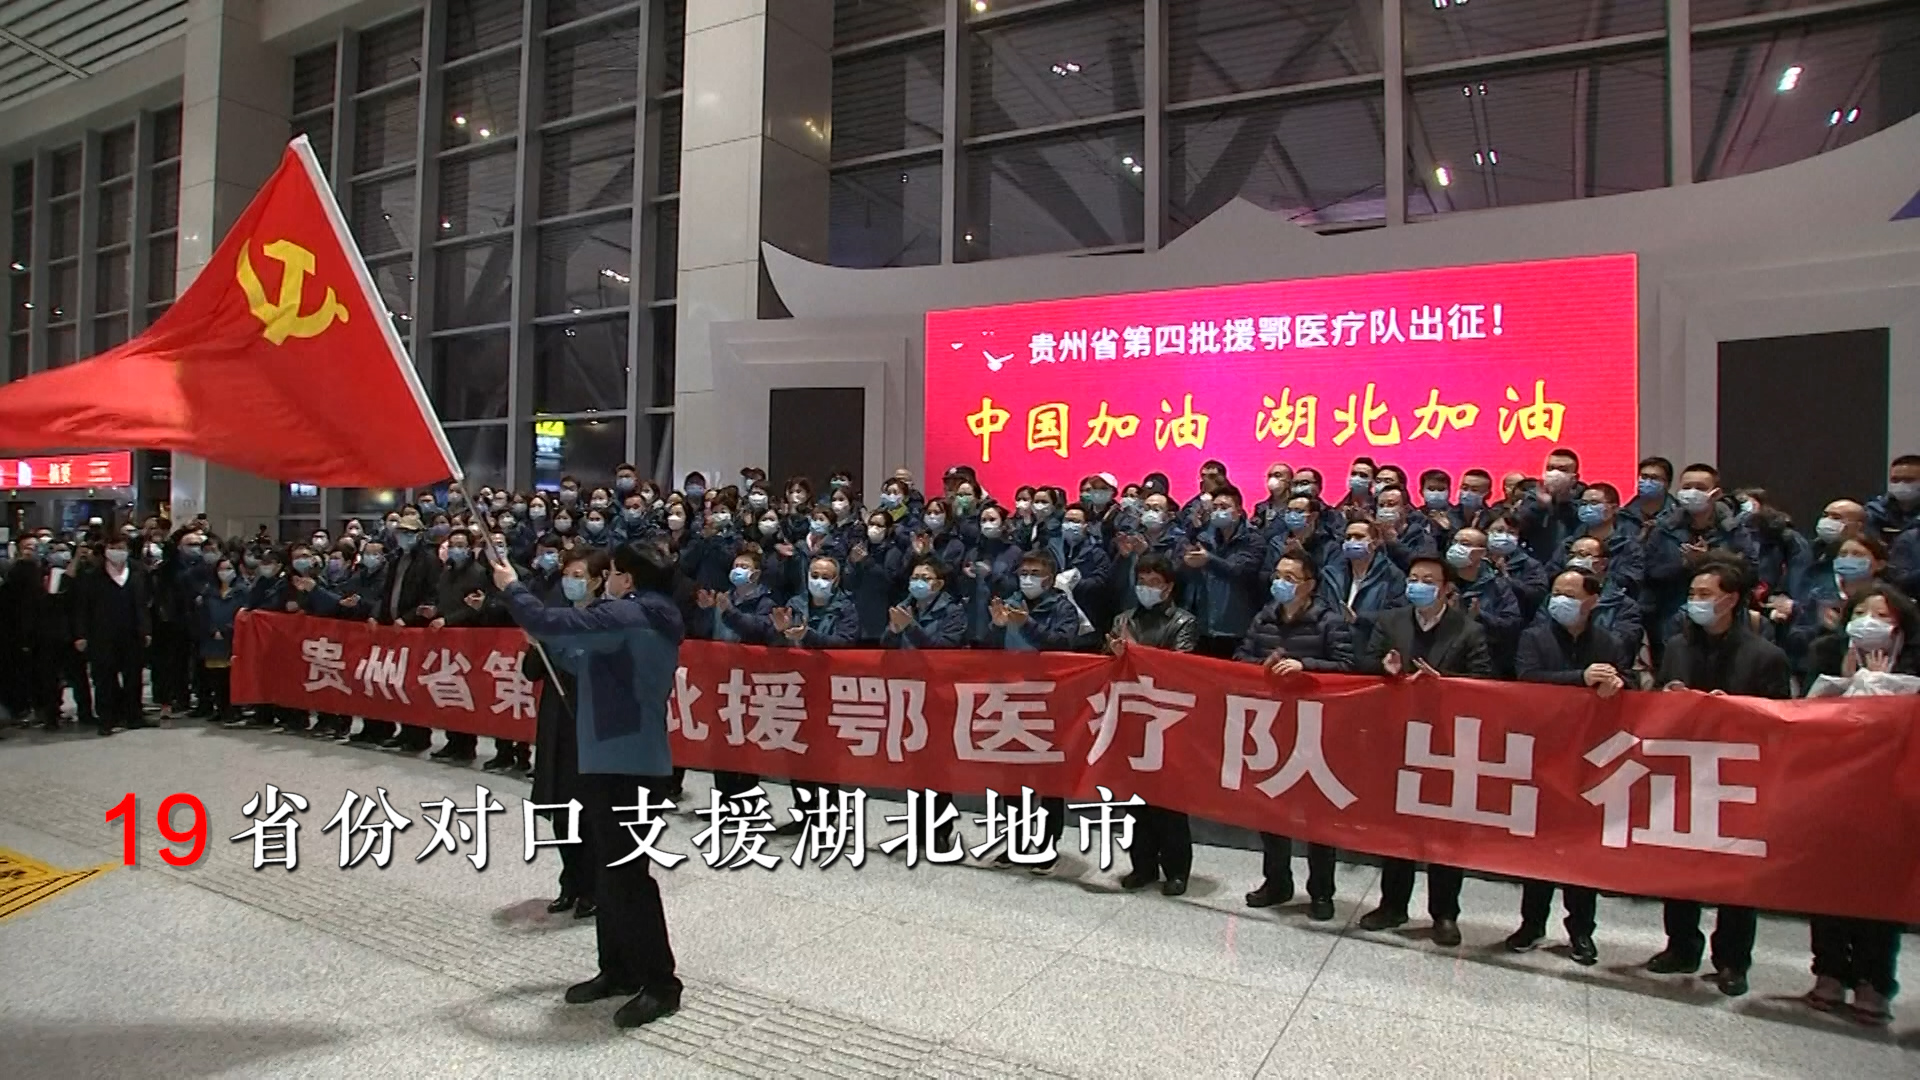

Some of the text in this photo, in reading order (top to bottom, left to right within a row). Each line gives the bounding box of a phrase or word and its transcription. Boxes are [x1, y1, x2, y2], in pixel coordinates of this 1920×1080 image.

[1028, 303, 1503, 365] 贵州省第四批援鄂医疗队出征！
[965, 379, 1567, 462] 中国加油 湖北加油
[301, 636, 1768, 859] 贵州省第援鄂医疗队出征
